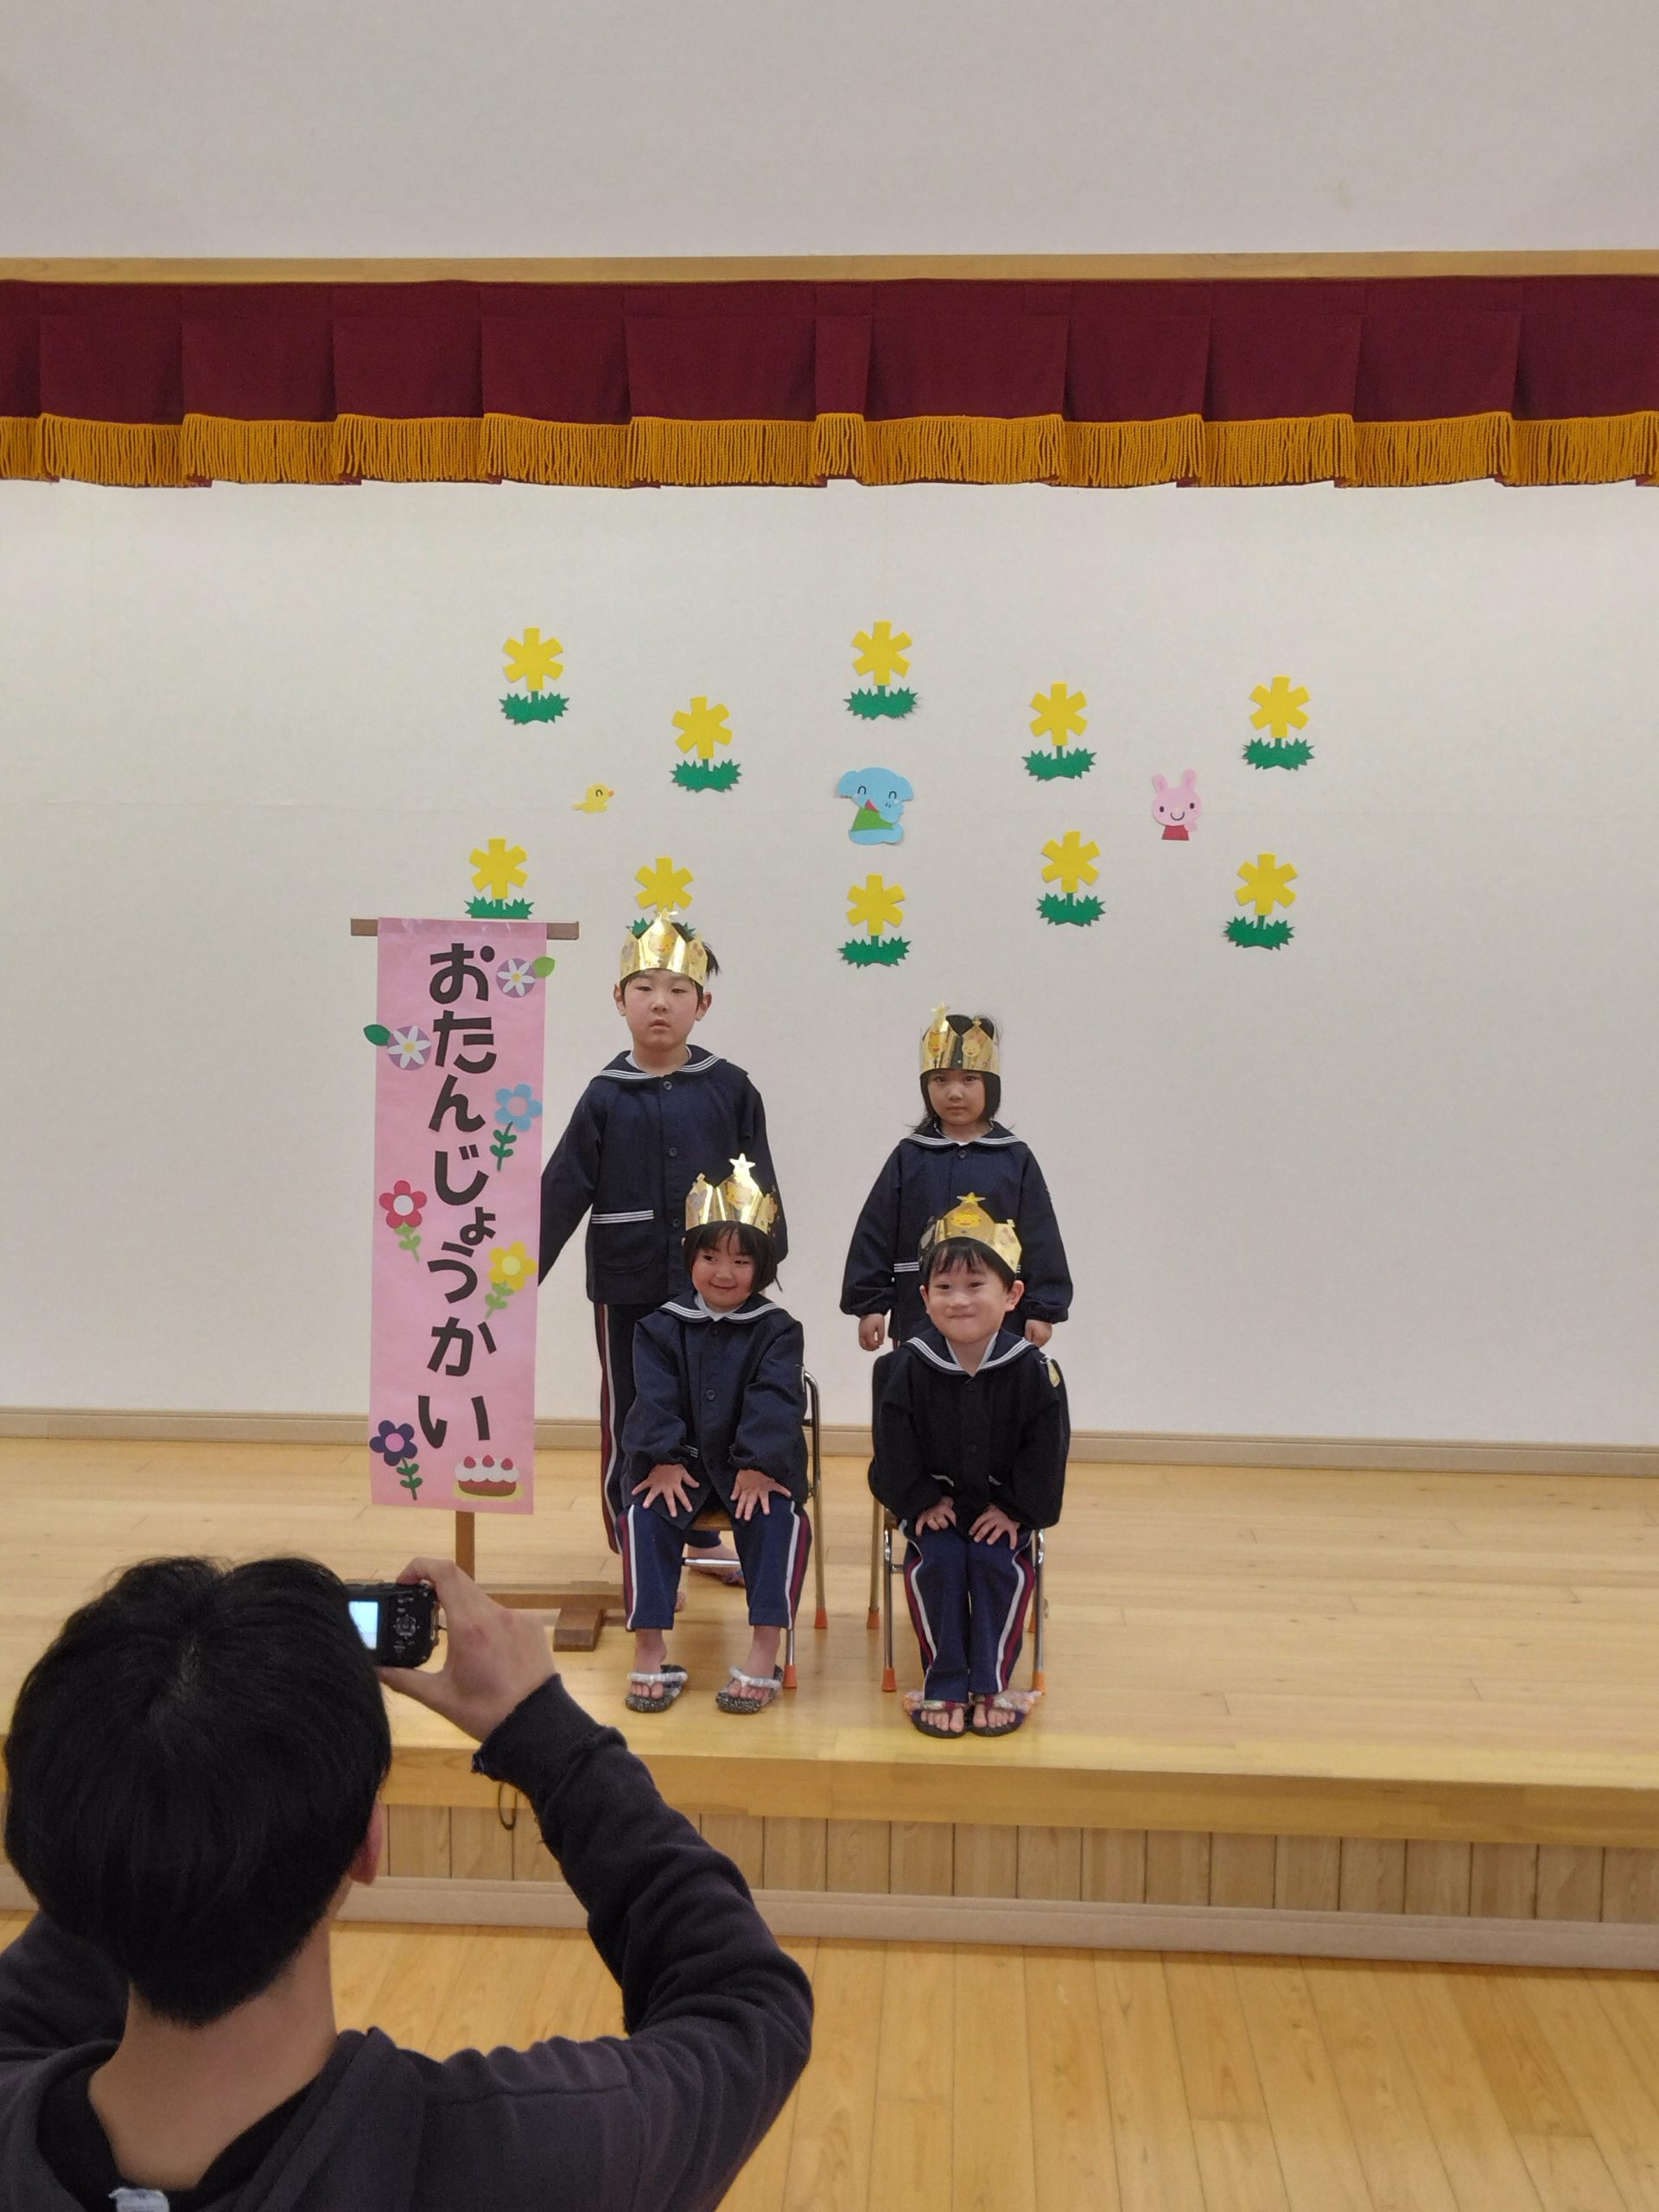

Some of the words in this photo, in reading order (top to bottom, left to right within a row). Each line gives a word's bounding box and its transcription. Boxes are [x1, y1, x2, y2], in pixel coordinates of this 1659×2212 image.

[417, 943, 497, 1449] おたんじょうかい
